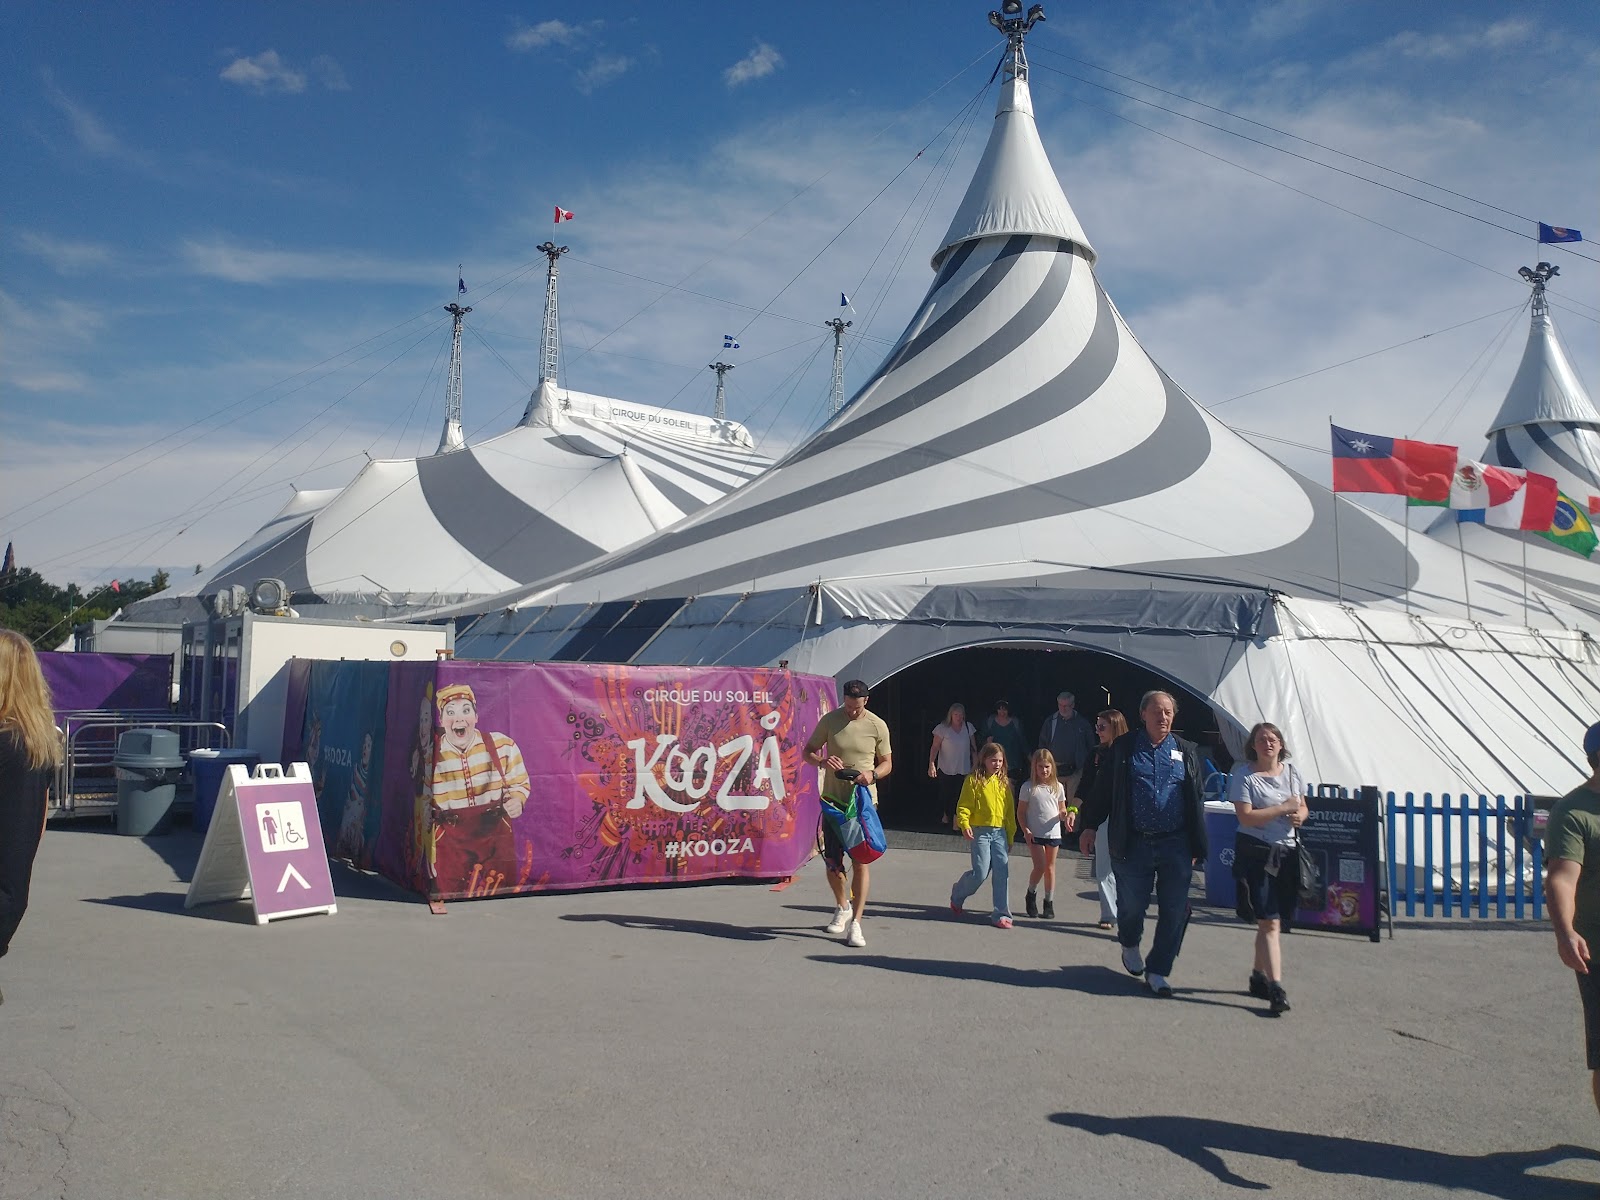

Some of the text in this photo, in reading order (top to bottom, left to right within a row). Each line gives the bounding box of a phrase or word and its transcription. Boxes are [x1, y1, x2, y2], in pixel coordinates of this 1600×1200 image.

[612, 407, 693, 429] CIRQUE DU SOLEIL
[643, 690, 773, 706] CIRQUE DU SOLEIL
[1308, 810, 1365, 823] envenue
[665, 837, 755, 859] #KOOZA
